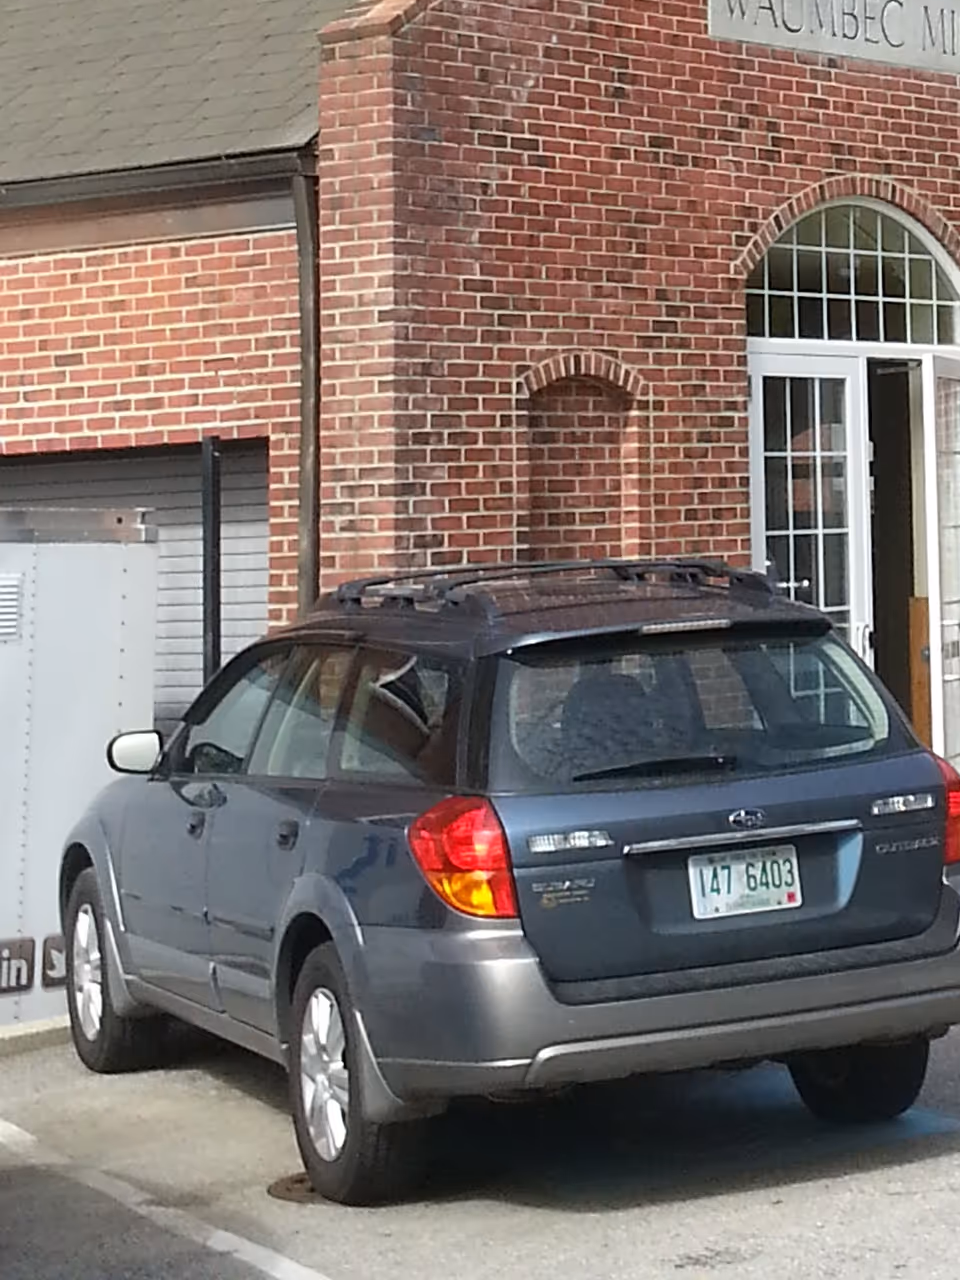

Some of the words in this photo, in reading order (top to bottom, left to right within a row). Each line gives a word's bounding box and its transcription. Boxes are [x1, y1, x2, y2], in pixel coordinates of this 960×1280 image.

[699, 865, 732, 898] 147
[745, 857, 795, 892] 6403
[1, 949, 28, 987] in
